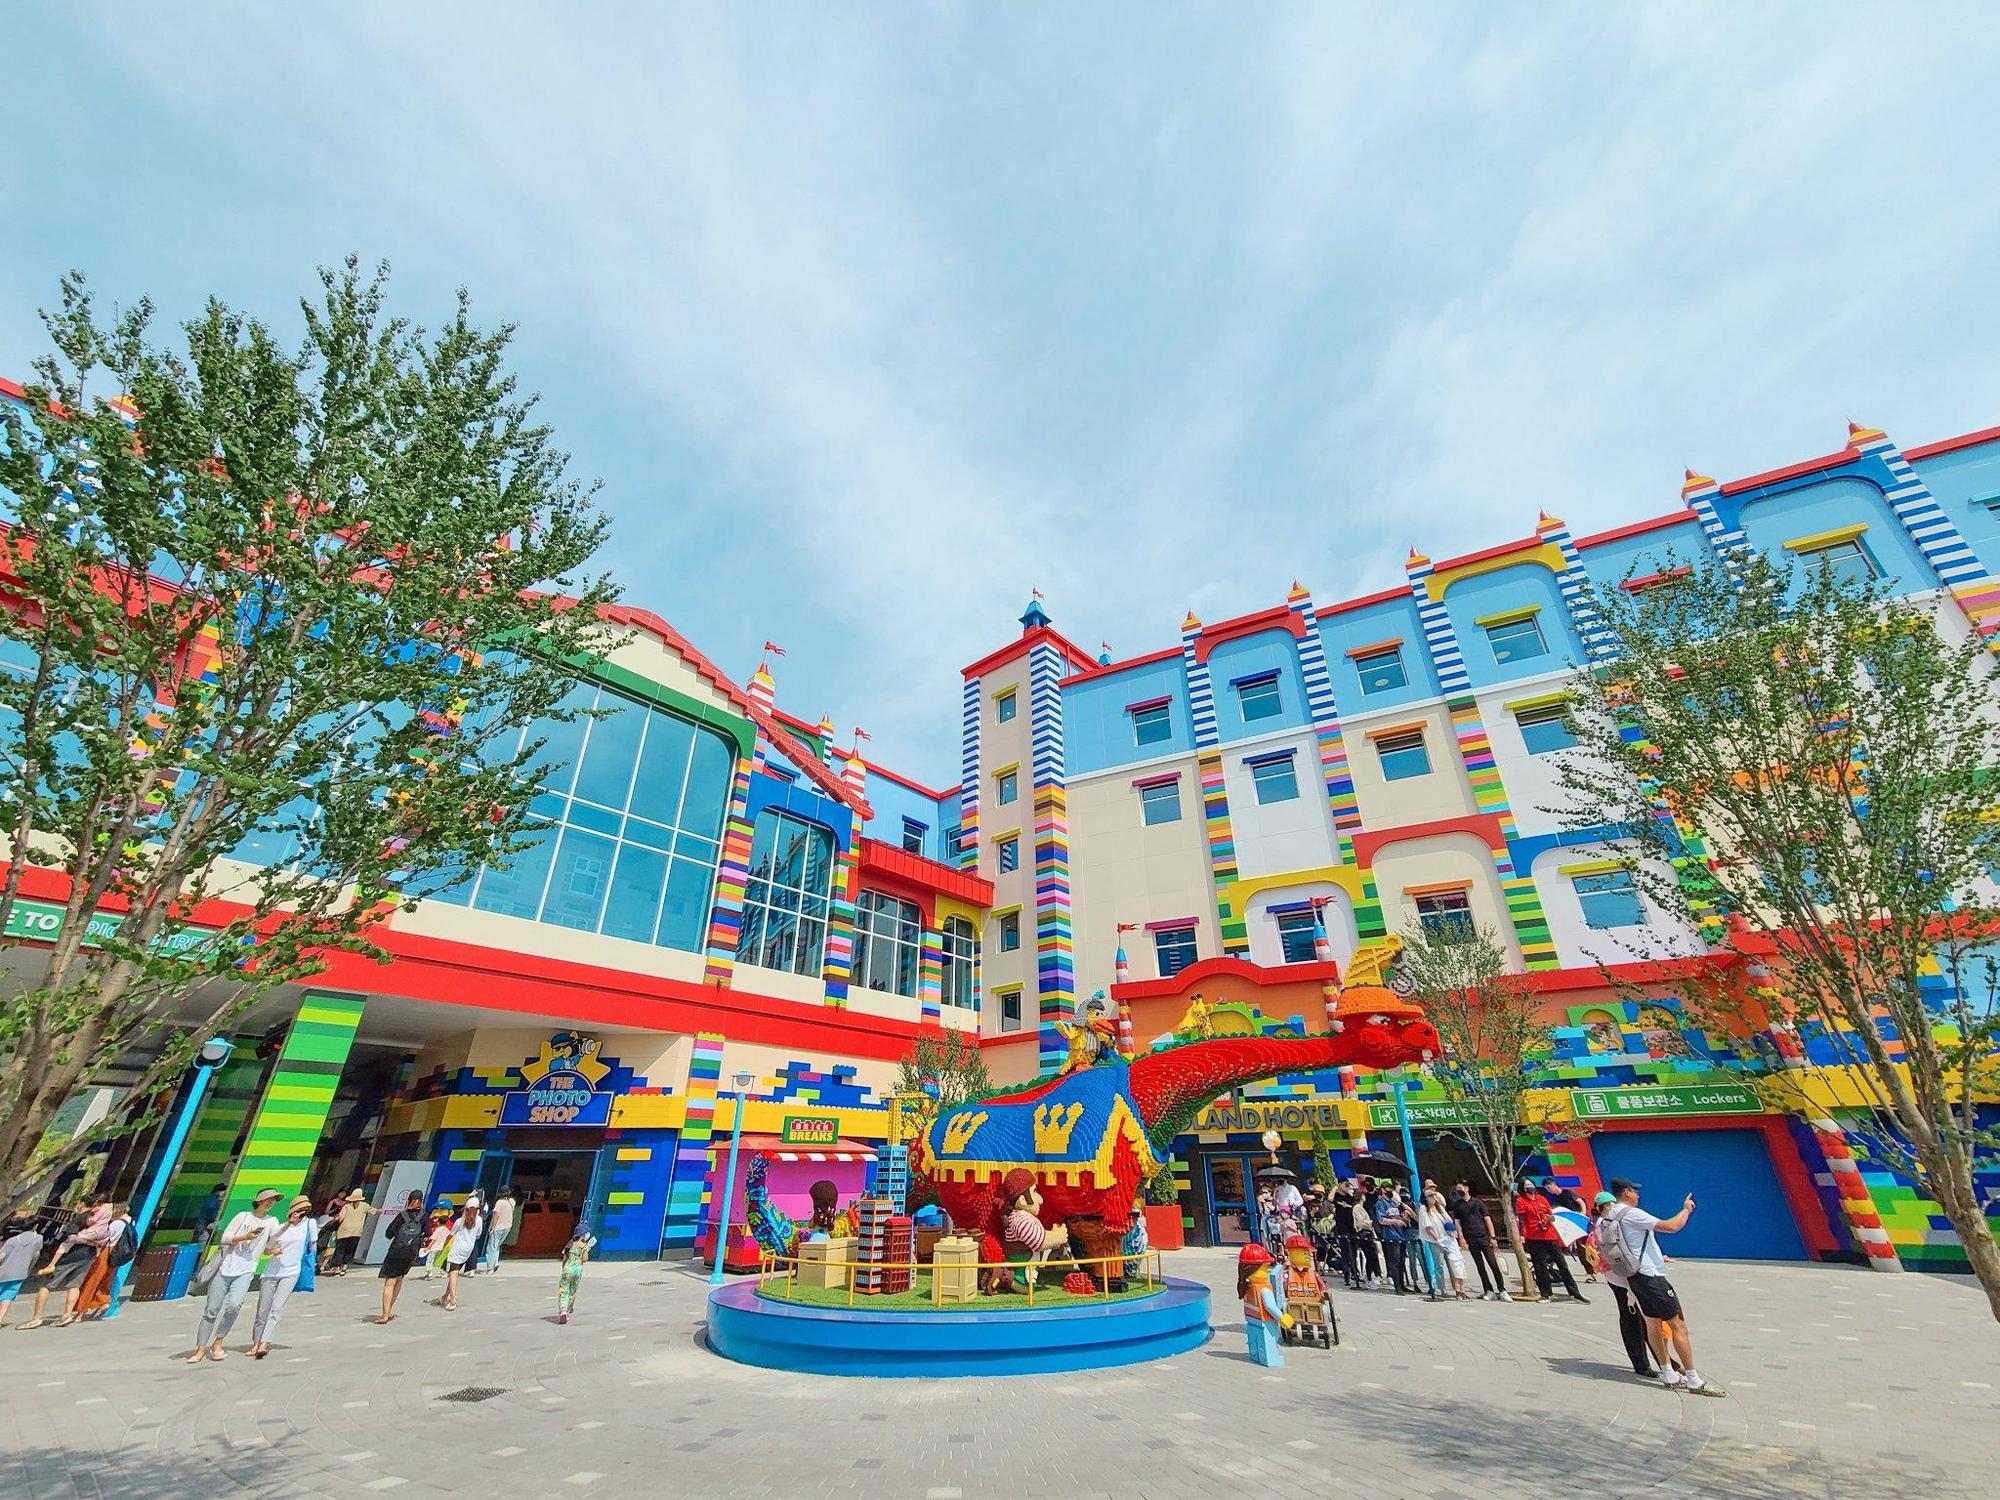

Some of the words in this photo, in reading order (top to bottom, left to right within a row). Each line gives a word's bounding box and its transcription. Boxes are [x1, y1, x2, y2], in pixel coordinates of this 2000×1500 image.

[24, 911, 59, 931] TO
[549, 1077, 575, 1090] THE
[527, 1089, 592, 1106] PHOTO
[1616, 1094, 1685, 1110] 물품보관소
[1693, 1092, 1747, 1105] Lockers
[528, 1105, 580, 1123] SHOP
[1263, 1104, 1348, 1129] HOTEL
[789, 1131, 834, 1141] BREAKS
